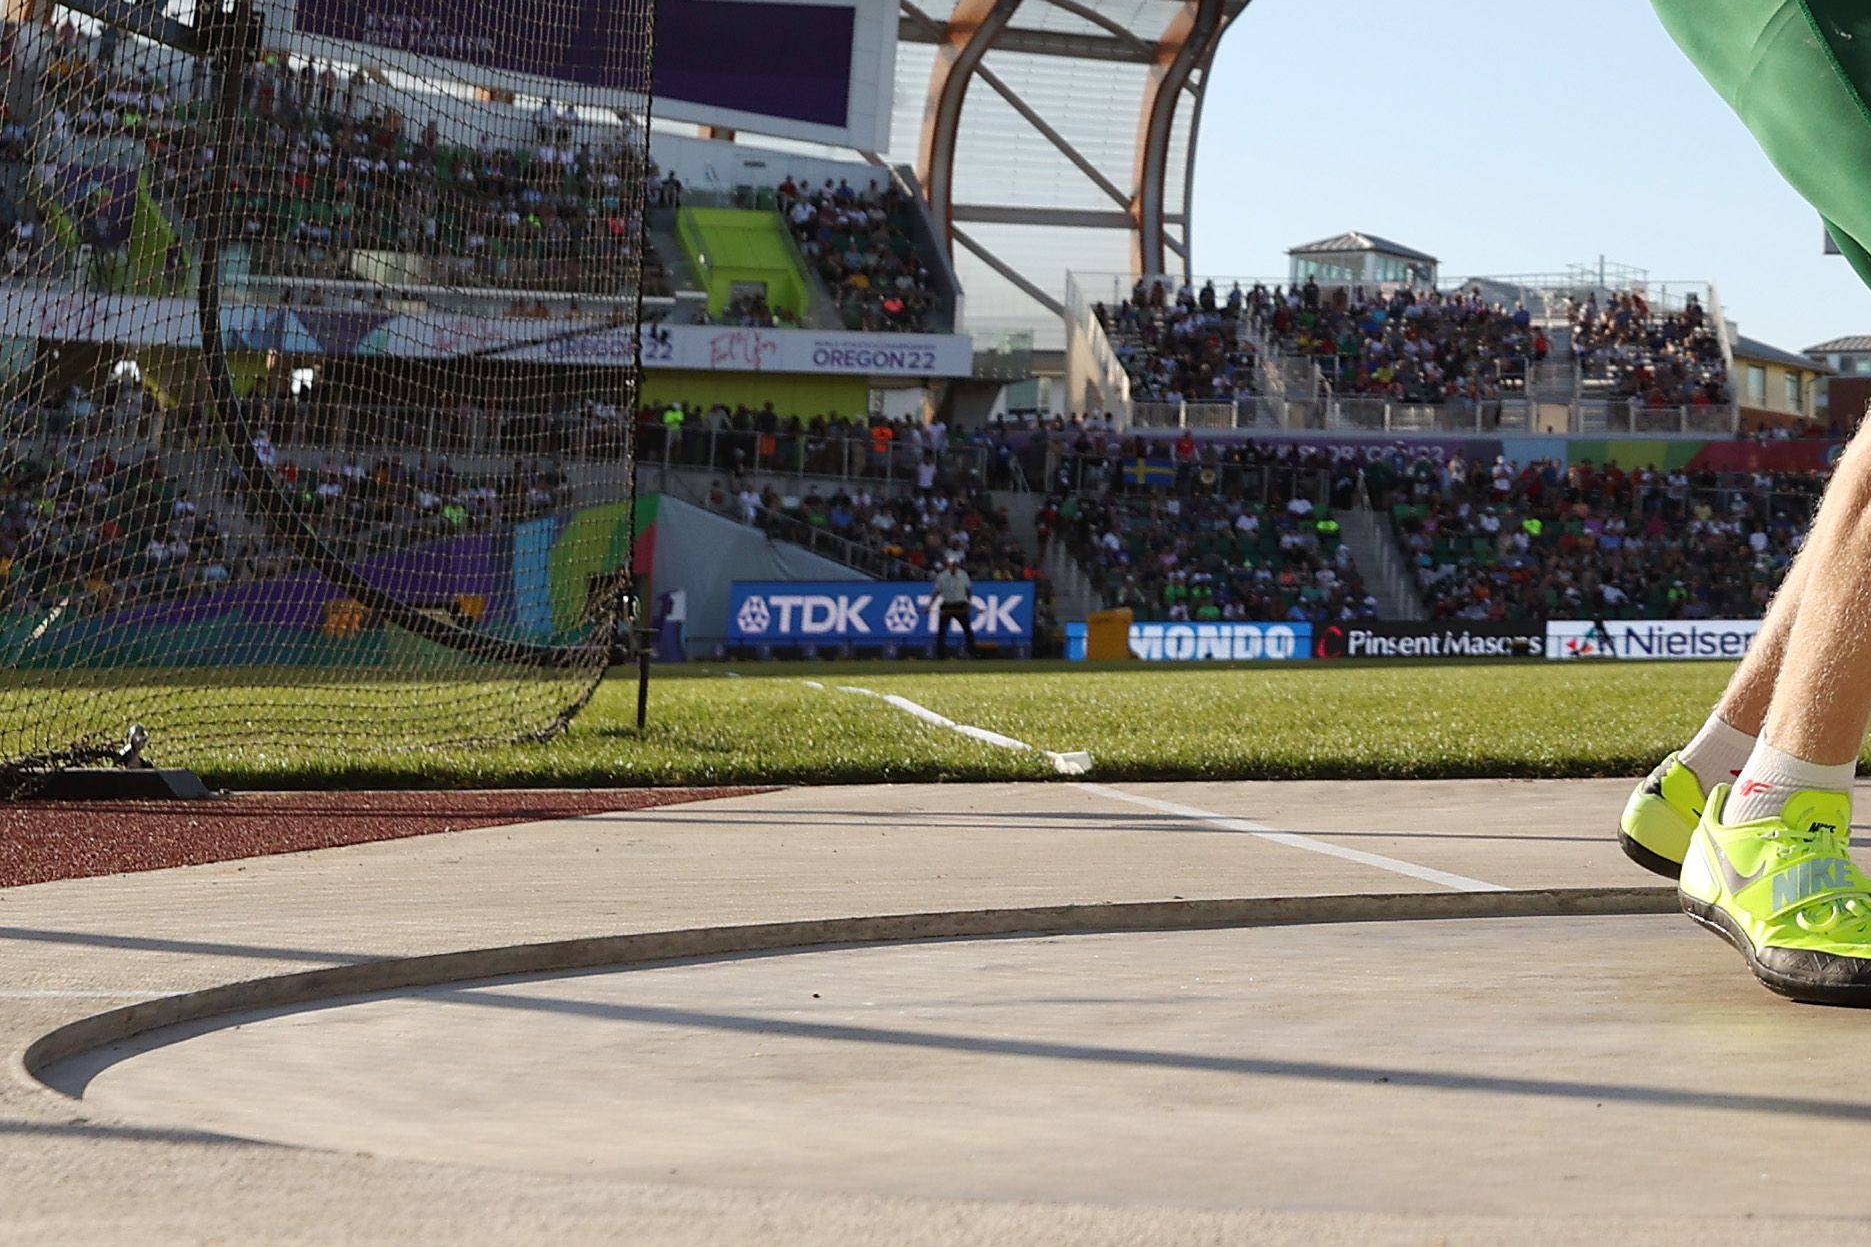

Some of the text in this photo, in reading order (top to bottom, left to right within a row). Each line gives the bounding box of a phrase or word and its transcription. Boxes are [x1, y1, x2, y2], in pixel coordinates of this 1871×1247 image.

[769, 595, 873, 633] TDK
[1129, 625, 1295, 659] MONDO
[1349, 631, 1440, 656] Pinsent
[1772, 858, 1855, 911] NIKE
